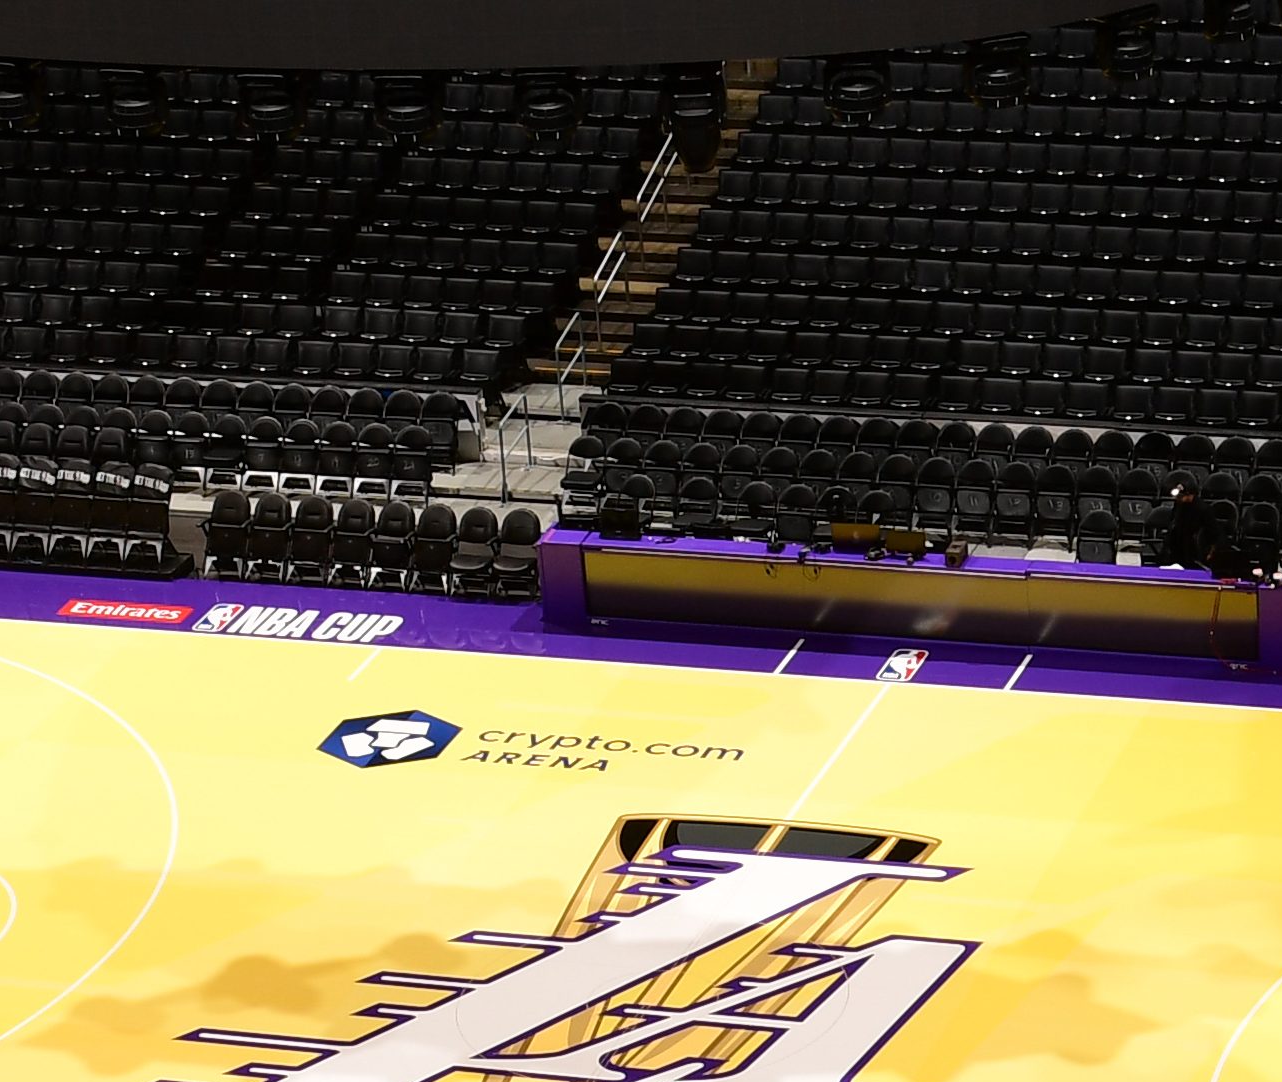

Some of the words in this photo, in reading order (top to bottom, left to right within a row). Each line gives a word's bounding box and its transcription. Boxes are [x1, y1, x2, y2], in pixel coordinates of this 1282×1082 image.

[70, 600, 183, 621] Emirates
[228, 606, 320, 639] NBA
[311, 610, 405, 643] CUP
[477, 729, 746, 762] crypto.com
[460, 750, 610, 772] ARENA
